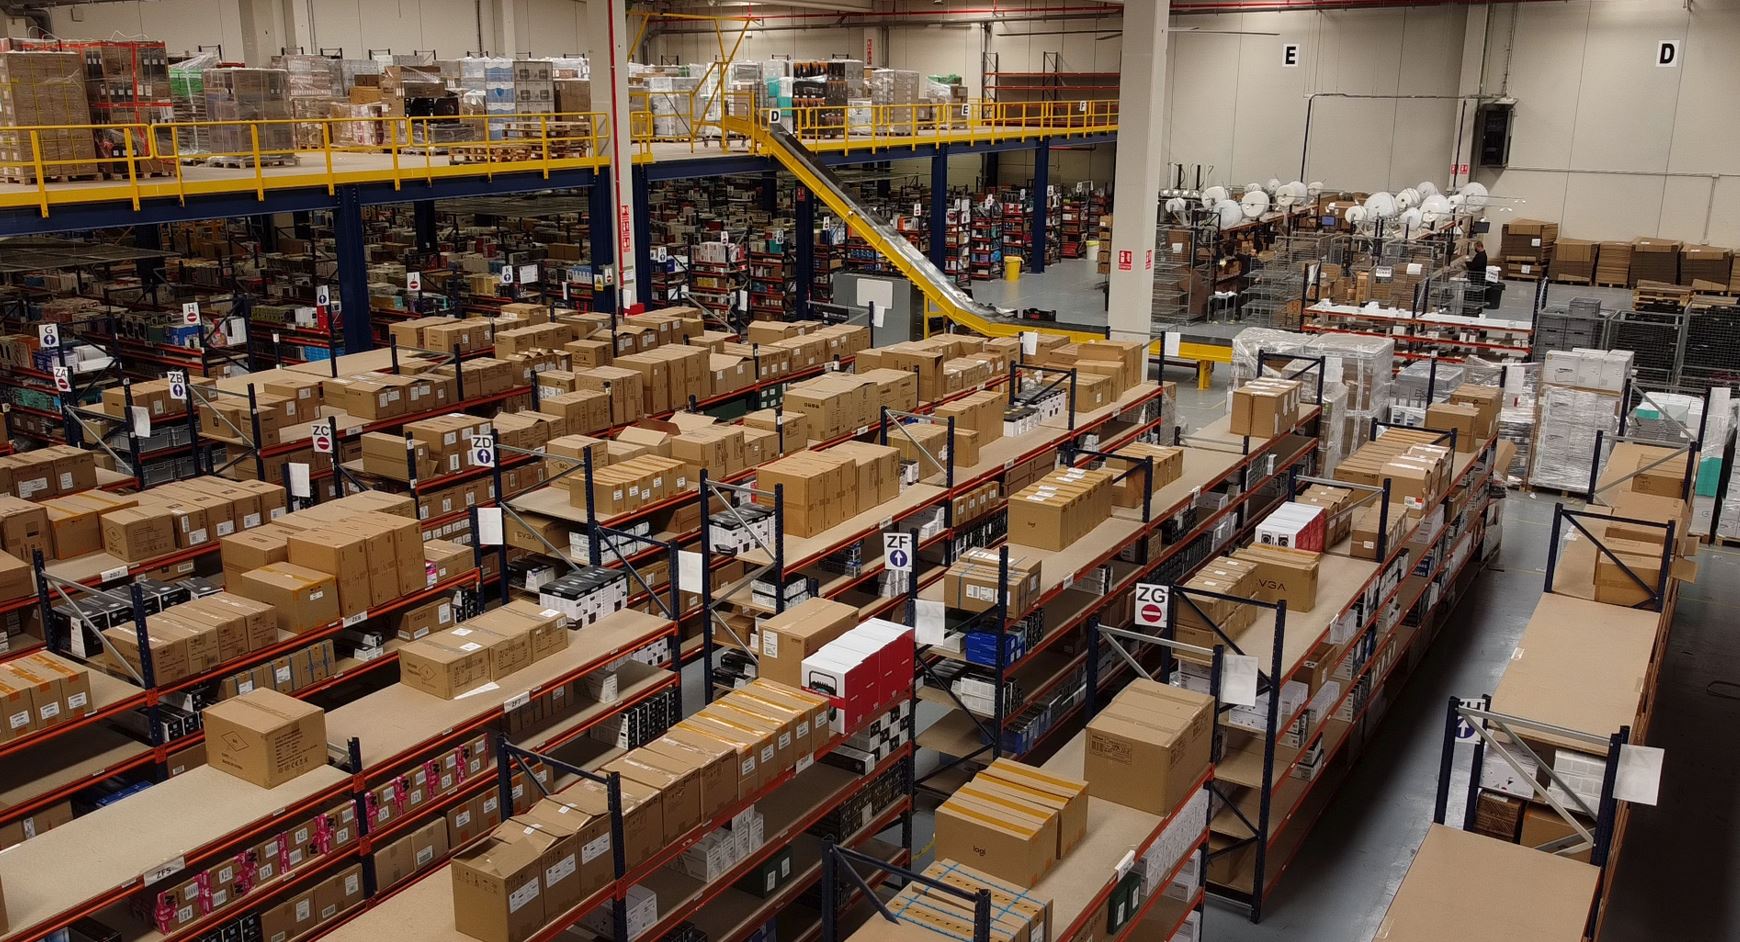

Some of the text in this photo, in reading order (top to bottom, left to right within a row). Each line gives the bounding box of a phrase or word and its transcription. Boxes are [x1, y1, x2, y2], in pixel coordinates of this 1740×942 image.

[1285, 46, 1297, 65] E
[1659, 43, 1675, 64] D
[963, 105, 969, 114] E
[771, 110, 780, 122] D
[188, 304, 195, 313] H
[45, 326, 53, 334] G
[56, 368, 68, 379] ZA
[169, 373, 183, 384] ZB
[313, 425, 330, 436] ZC
[473, 437, 491, 447] ZD
[887, 535, 909, 549] ZF
[1137, 586, 1167, 604] ZG
[972, 845, 986, 857] logi
[156, 867, 172, 880] ZF5
